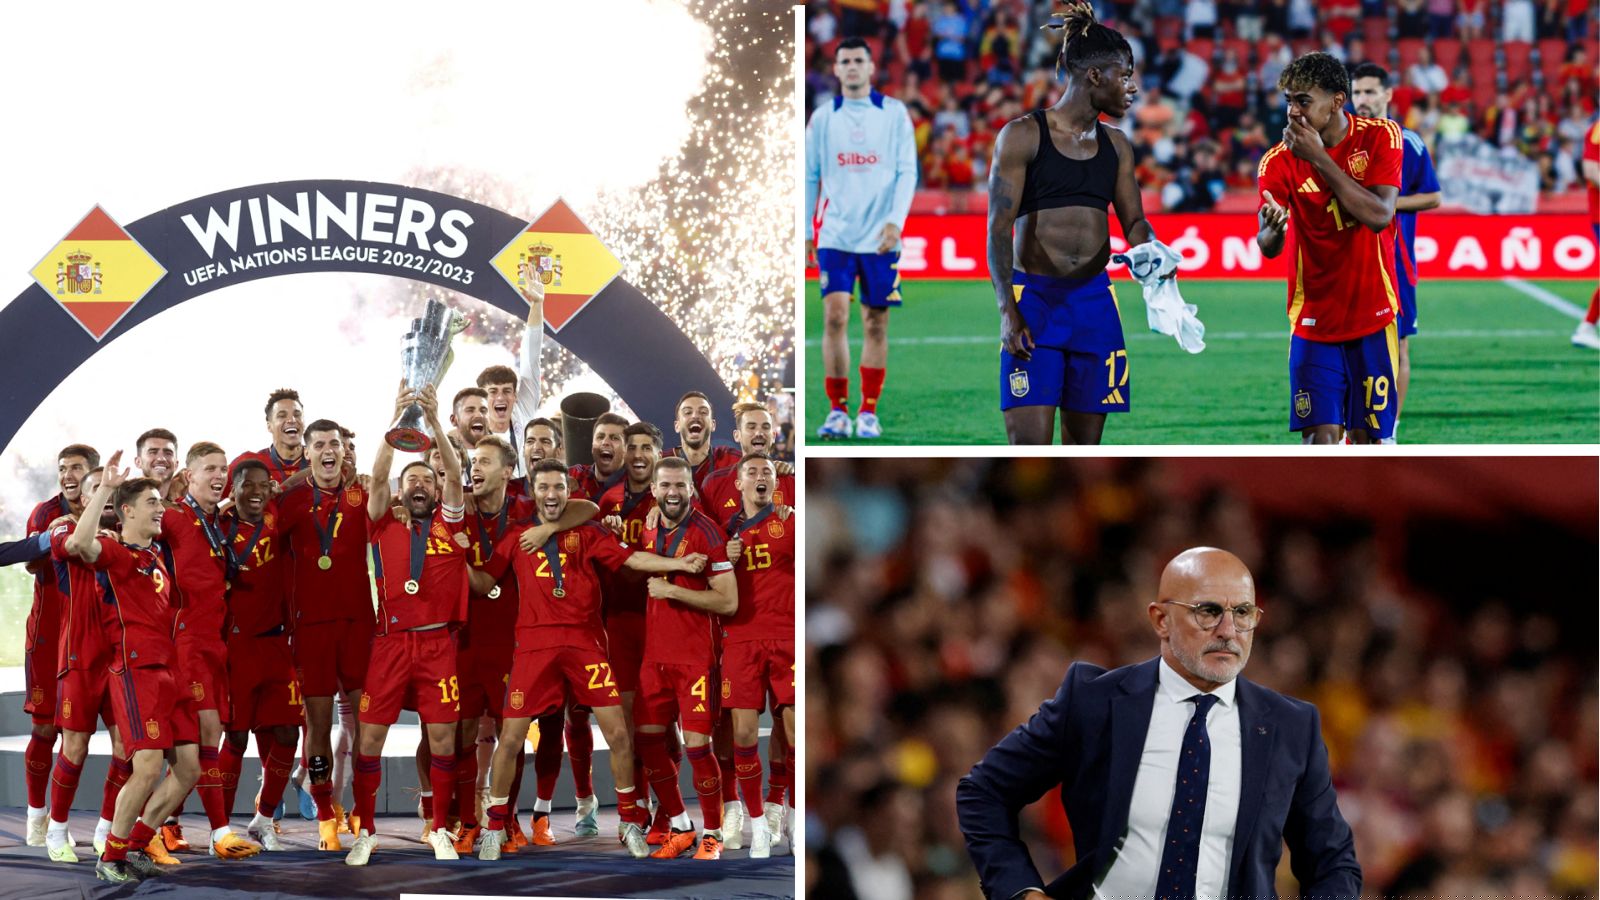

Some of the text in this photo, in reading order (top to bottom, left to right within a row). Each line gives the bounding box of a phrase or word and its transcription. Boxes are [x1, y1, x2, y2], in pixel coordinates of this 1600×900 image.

[180, 189, 475, 260] WINNERS
[183, 246, 475, 286] UEFA NATIONS LEAGUE 2022/2023
[1105, 349, 1129, 388] 17
[1363, 375, 1390, 411] 19
[252, 536, 274, 567] 12
[743, 543, 772, 571] 15
[152, 568, 165, 593] 9
[437, 675, 460, 703] 18
[584, 662, 616, 690] 22
[691, 675, 706, 701] 4
